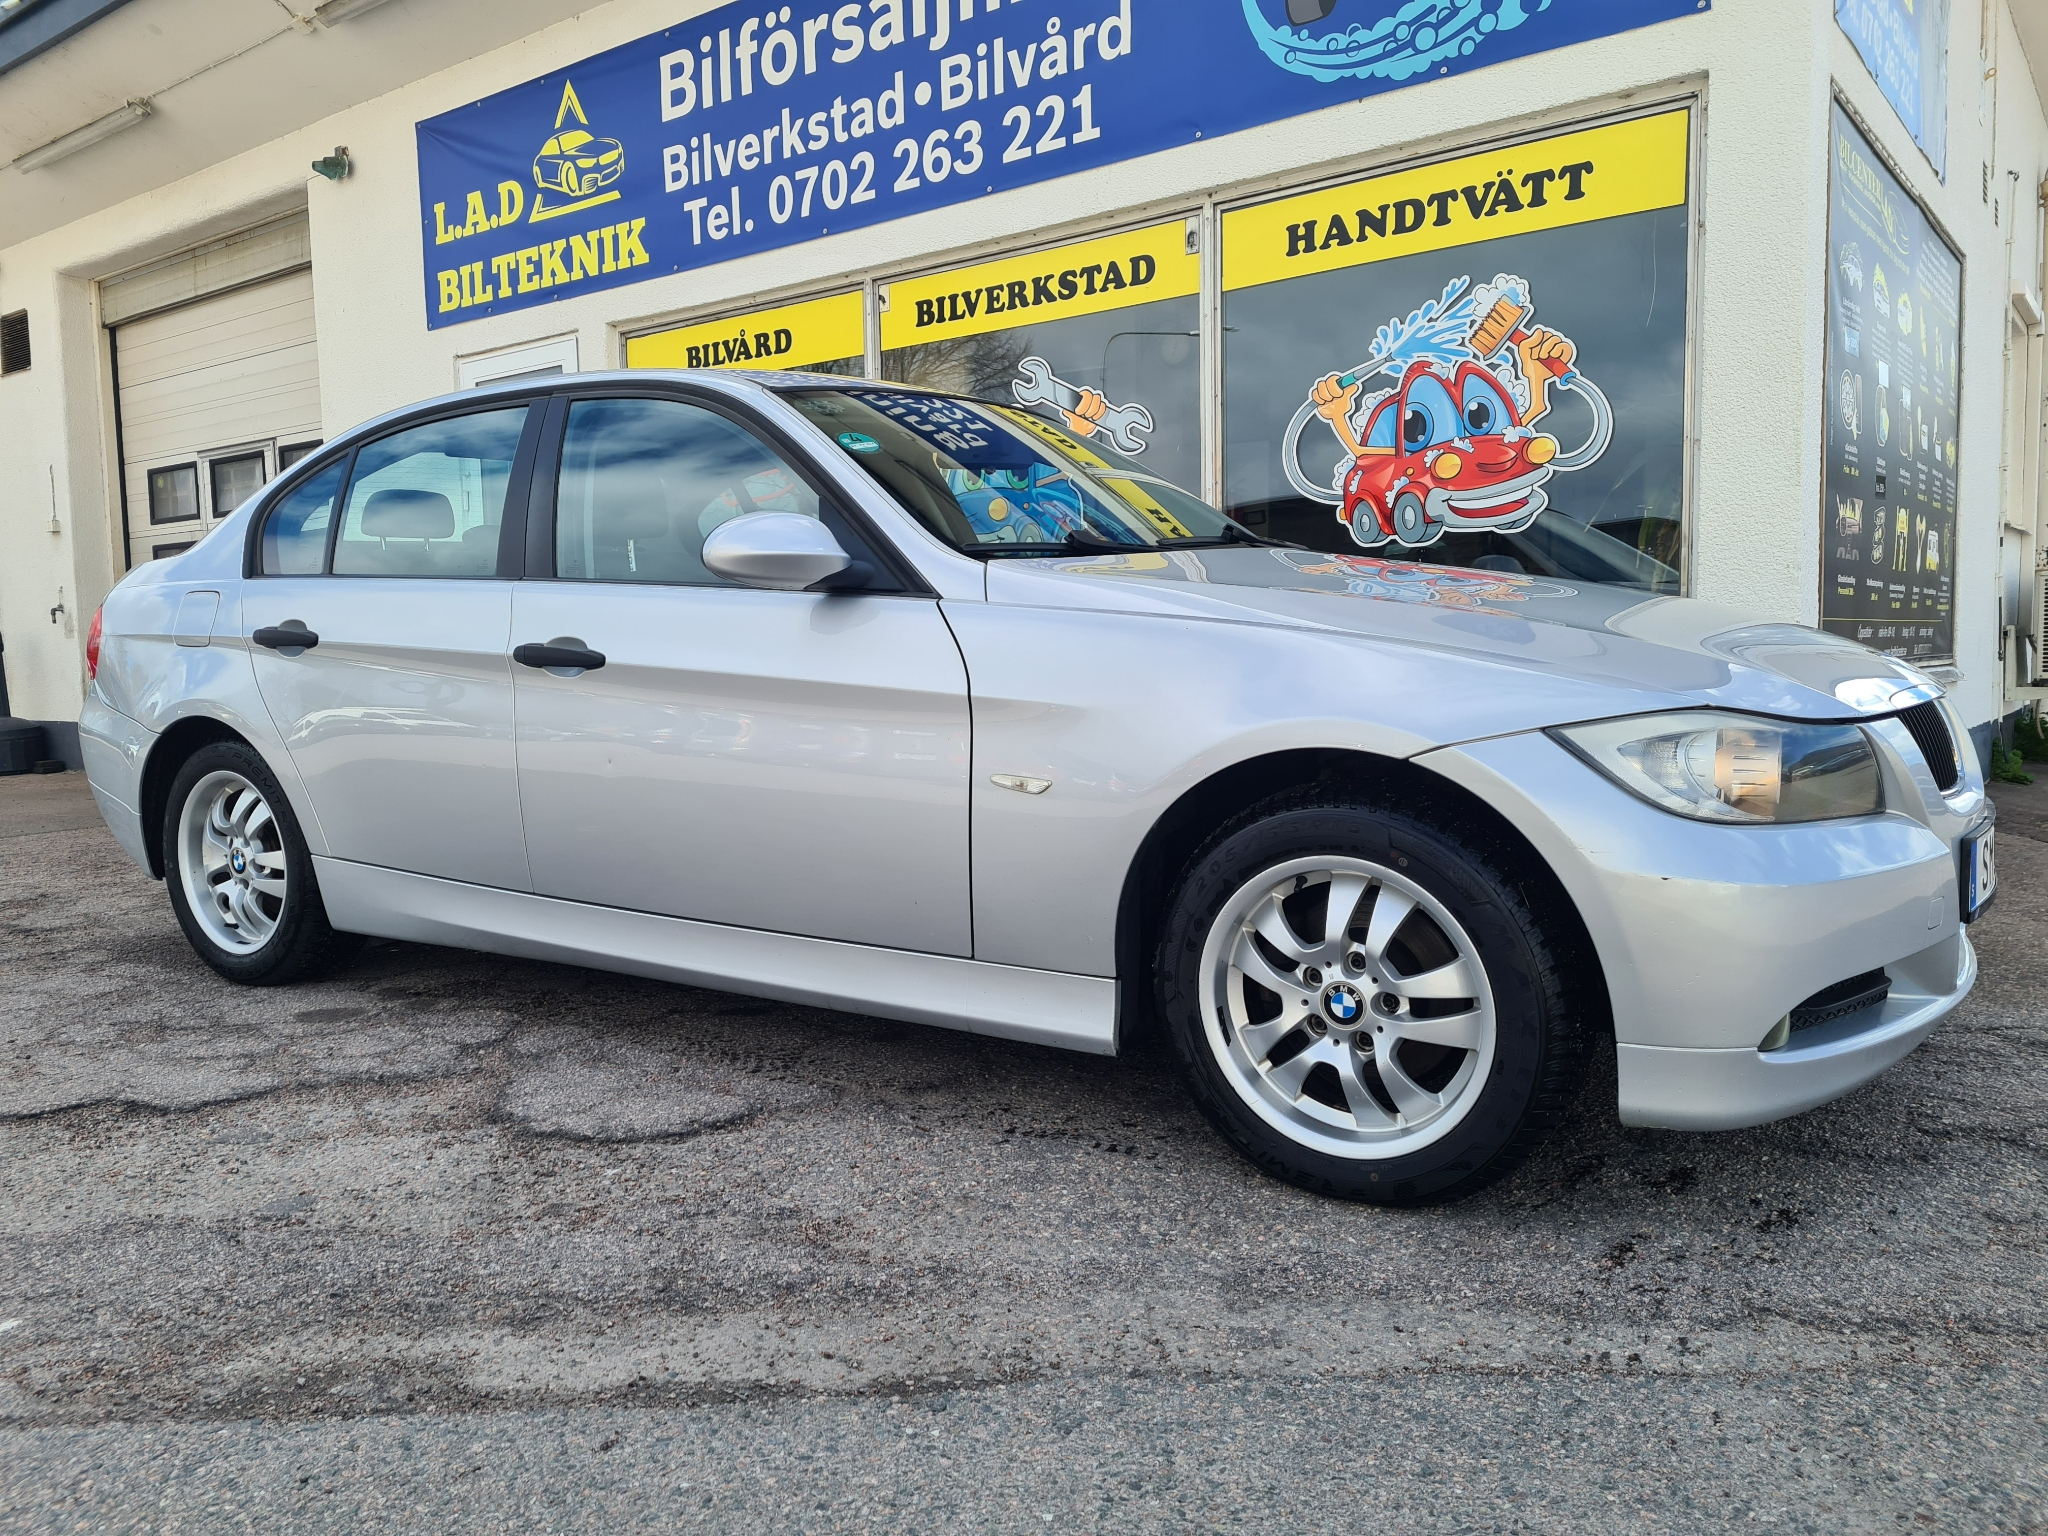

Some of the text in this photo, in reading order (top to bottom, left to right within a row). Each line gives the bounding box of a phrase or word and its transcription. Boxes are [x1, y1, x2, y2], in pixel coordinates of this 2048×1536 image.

[663, 0, 1132, 193] Bilverkstad Bilvård
[684, 84, 1101, 246] Tel. 0702 263 221
[434, 180, 525, 245] L.A.D
[1286, 161, 1594, 257] HANDTVÄTT
[437, 217, 650, 313] BILTEKNIK
[915, 254, 1157, 327] BILVERKSTAD
[686, 329, 792, 368] BILVÅRD
[1327, 985, 1361, 1001] BMW
